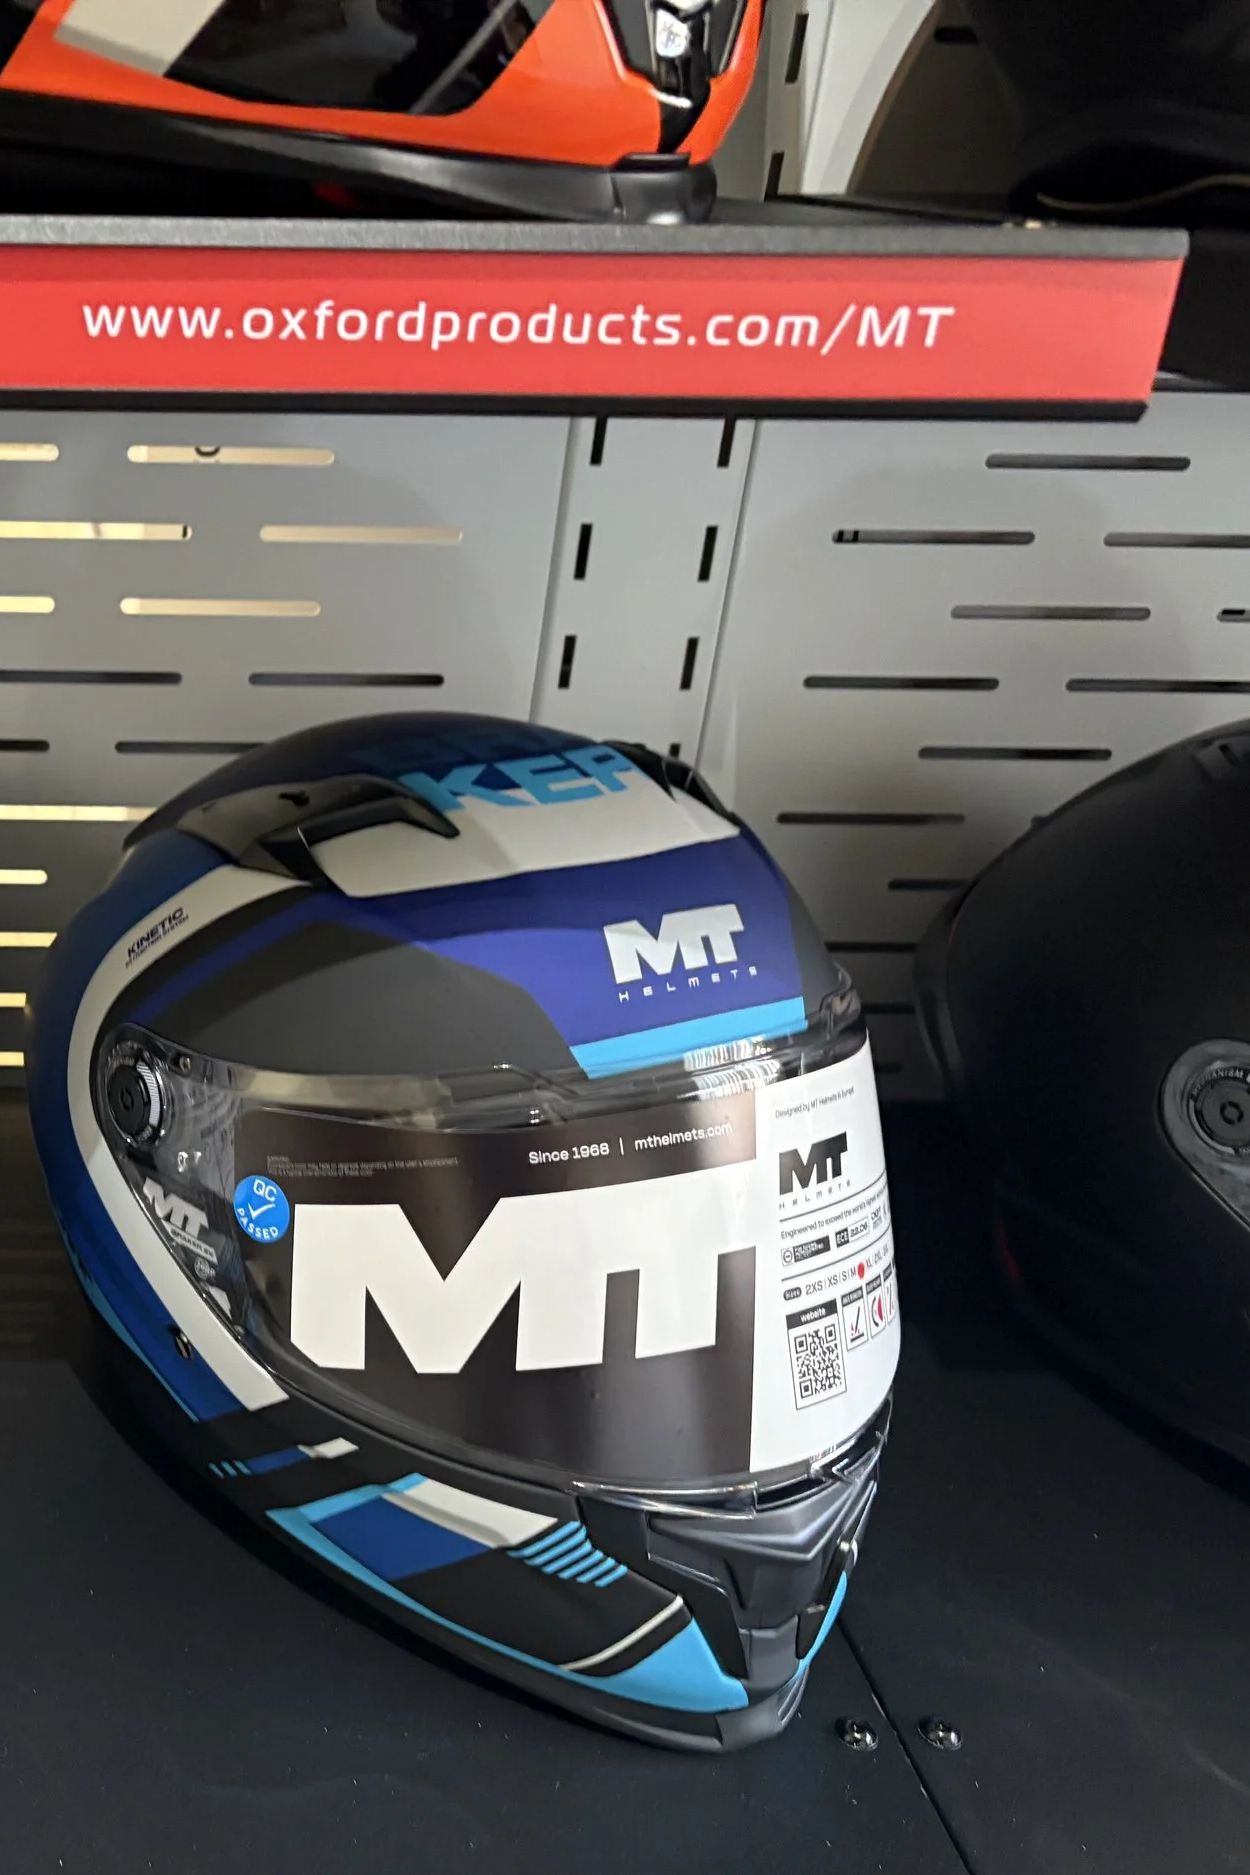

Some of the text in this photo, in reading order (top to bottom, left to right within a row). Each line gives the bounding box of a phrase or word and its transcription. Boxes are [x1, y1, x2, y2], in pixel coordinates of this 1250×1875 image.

[82, 301, 956, 355] www.oxfordproducts.com/MT
[603, 904, 745, 984] MT
[618, 966, 758, 1003] HELMETS
[529, 1122, 733, 1164] Since 1968 mthelmets.com
[779, 1131, 848, 1195] MT
[253, 1179, 278, 1202] QC
[236, 1207, 279, 1239] PASSED
[781, 1222, 817, 1239] Engineered
[836, 1229, 849, 1244] ECE
[291, 1159, 756, 1373] MT
[806, 1280, 823, 1296] 2XS
[827, 1273, 838, 1288] XS
